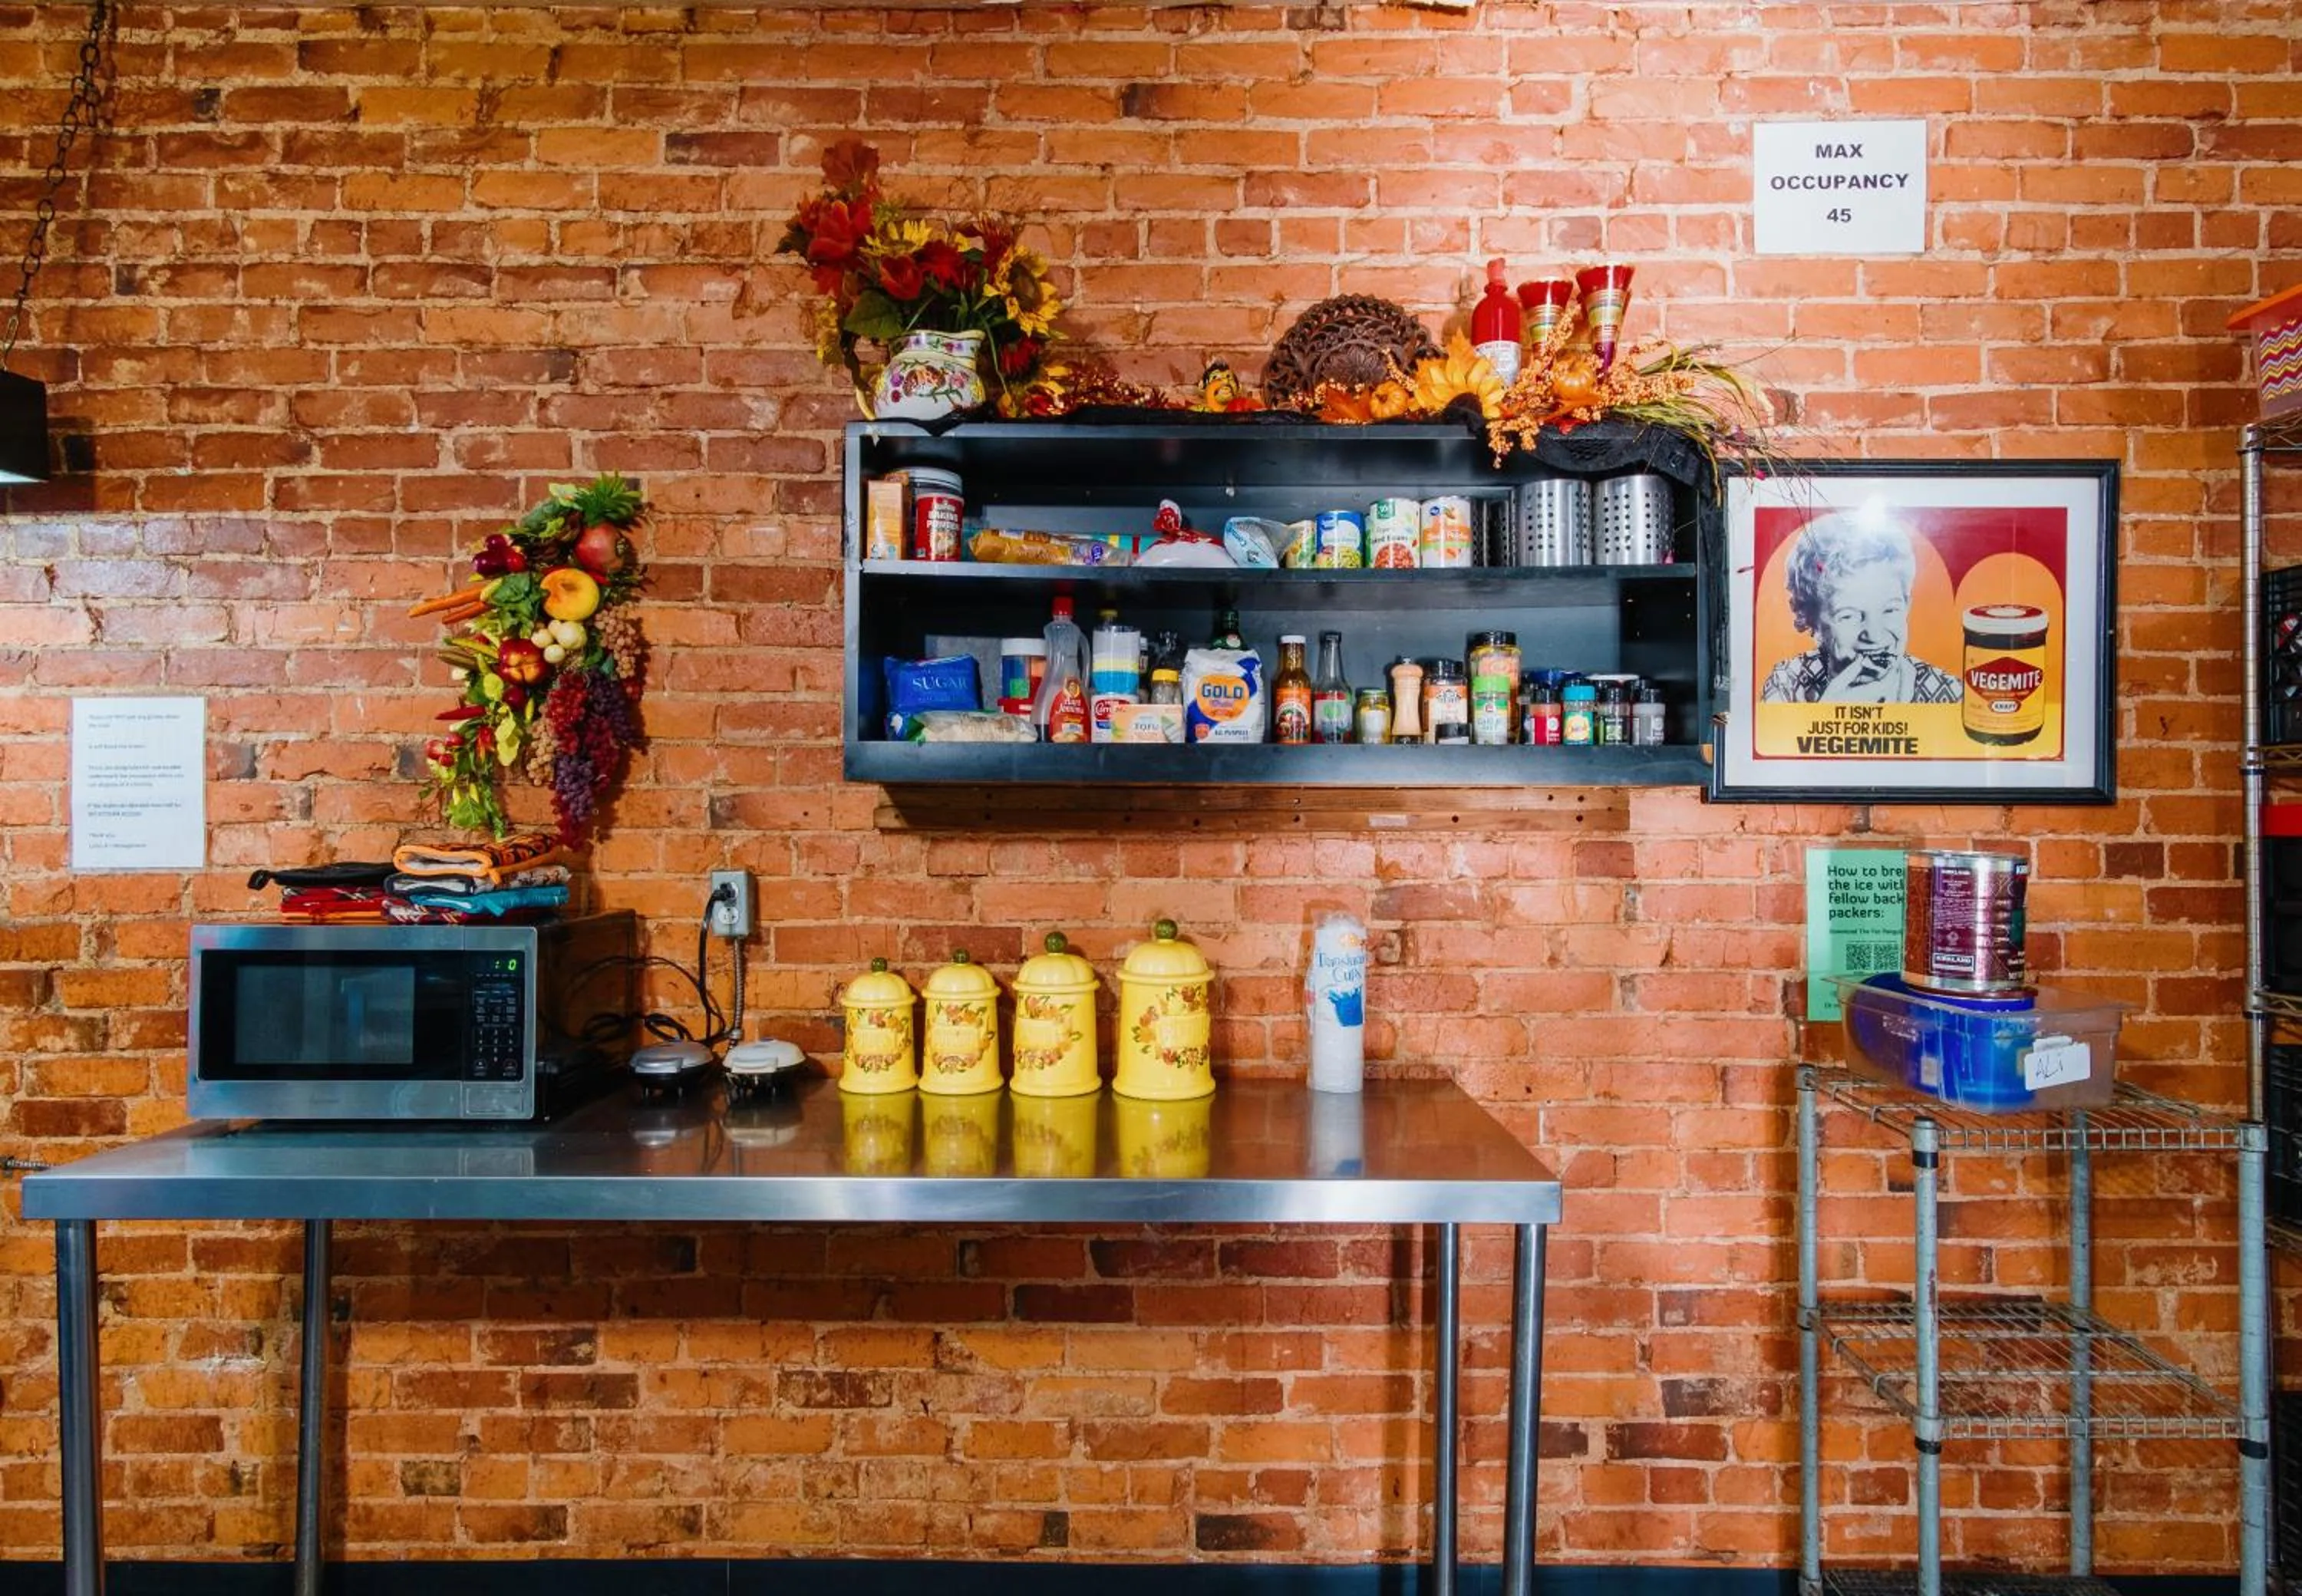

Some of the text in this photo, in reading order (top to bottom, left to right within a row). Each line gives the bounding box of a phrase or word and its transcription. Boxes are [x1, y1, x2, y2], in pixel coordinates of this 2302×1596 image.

[1816, 143, 1863, 158] MAX
[1770, 173, 1909, 190] OCCUPANCY
[1826, 208, 1852, 223] 45
[912, 676, 968, 690] SUGAR
[1971, 670, 2041, 691] VEGEMITE
[1202, 684, 1243, 700] GOLD
[1835, 707, 1883, 719] IT ISN'T
[1808, 721, 1908, 735] JUST FOR KIDS!
[1796, 737, 1918, 754] VEGEMITE
[1828, 865, 1903, 876] How to bre
[1829, 879, 1850, 890] the
[1855, 879, 1873, 890] ice
[1829, 892, 1869, 904] fellow
[1829, 906, 1885, 921] packers:
